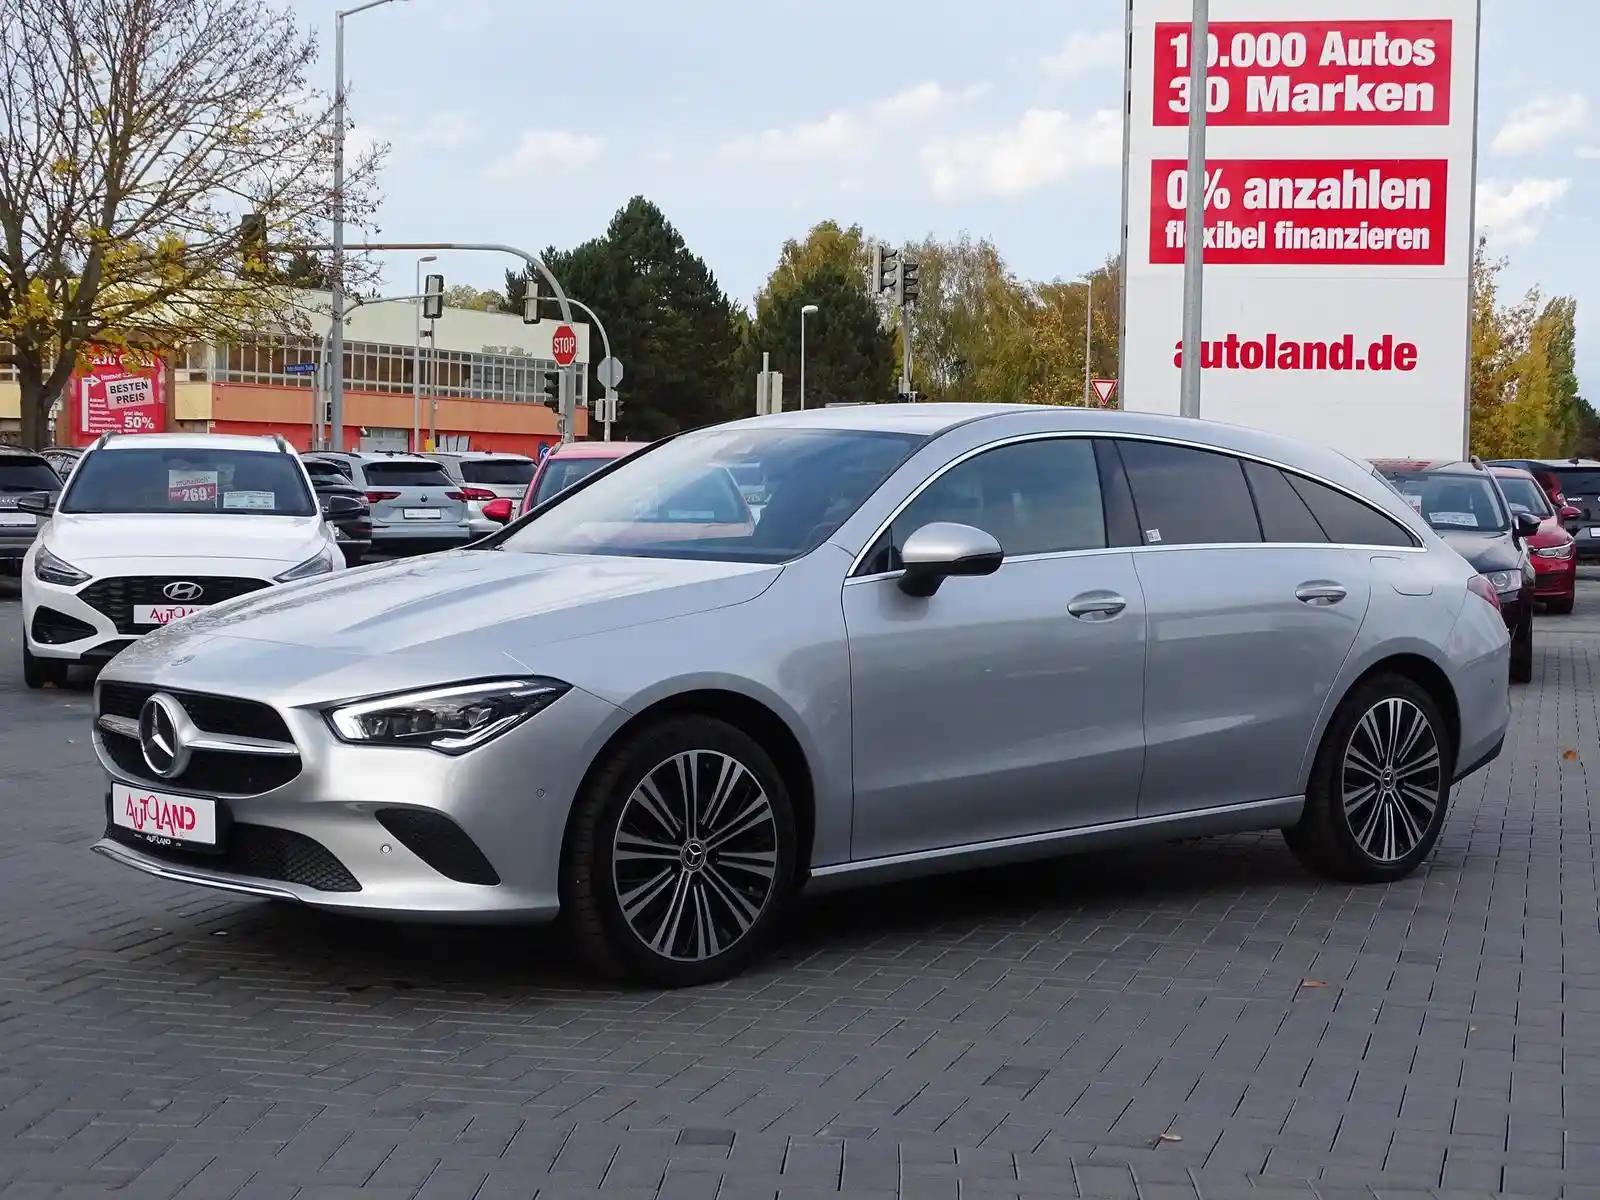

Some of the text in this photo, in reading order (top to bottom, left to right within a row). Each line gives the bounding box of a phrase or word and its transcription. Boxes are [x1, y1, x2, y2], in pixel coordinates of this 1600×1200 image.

[1319, 30, 1435, 67] Autos
[1168, 74, 1434, 113] 30 Marken
[1167, 168, 1431, 211] 0% anzahlen
[1165, 220, 1430, 250] flxibel finanzieren
[554, 337, 574, 353] STOP
[109, 381, 148, 394] BESTEN
[116, 392, 145, 404] PREIS
[124, 416, 154, 429] 50%
[126, 792, 196, 836] AUTOLAND
